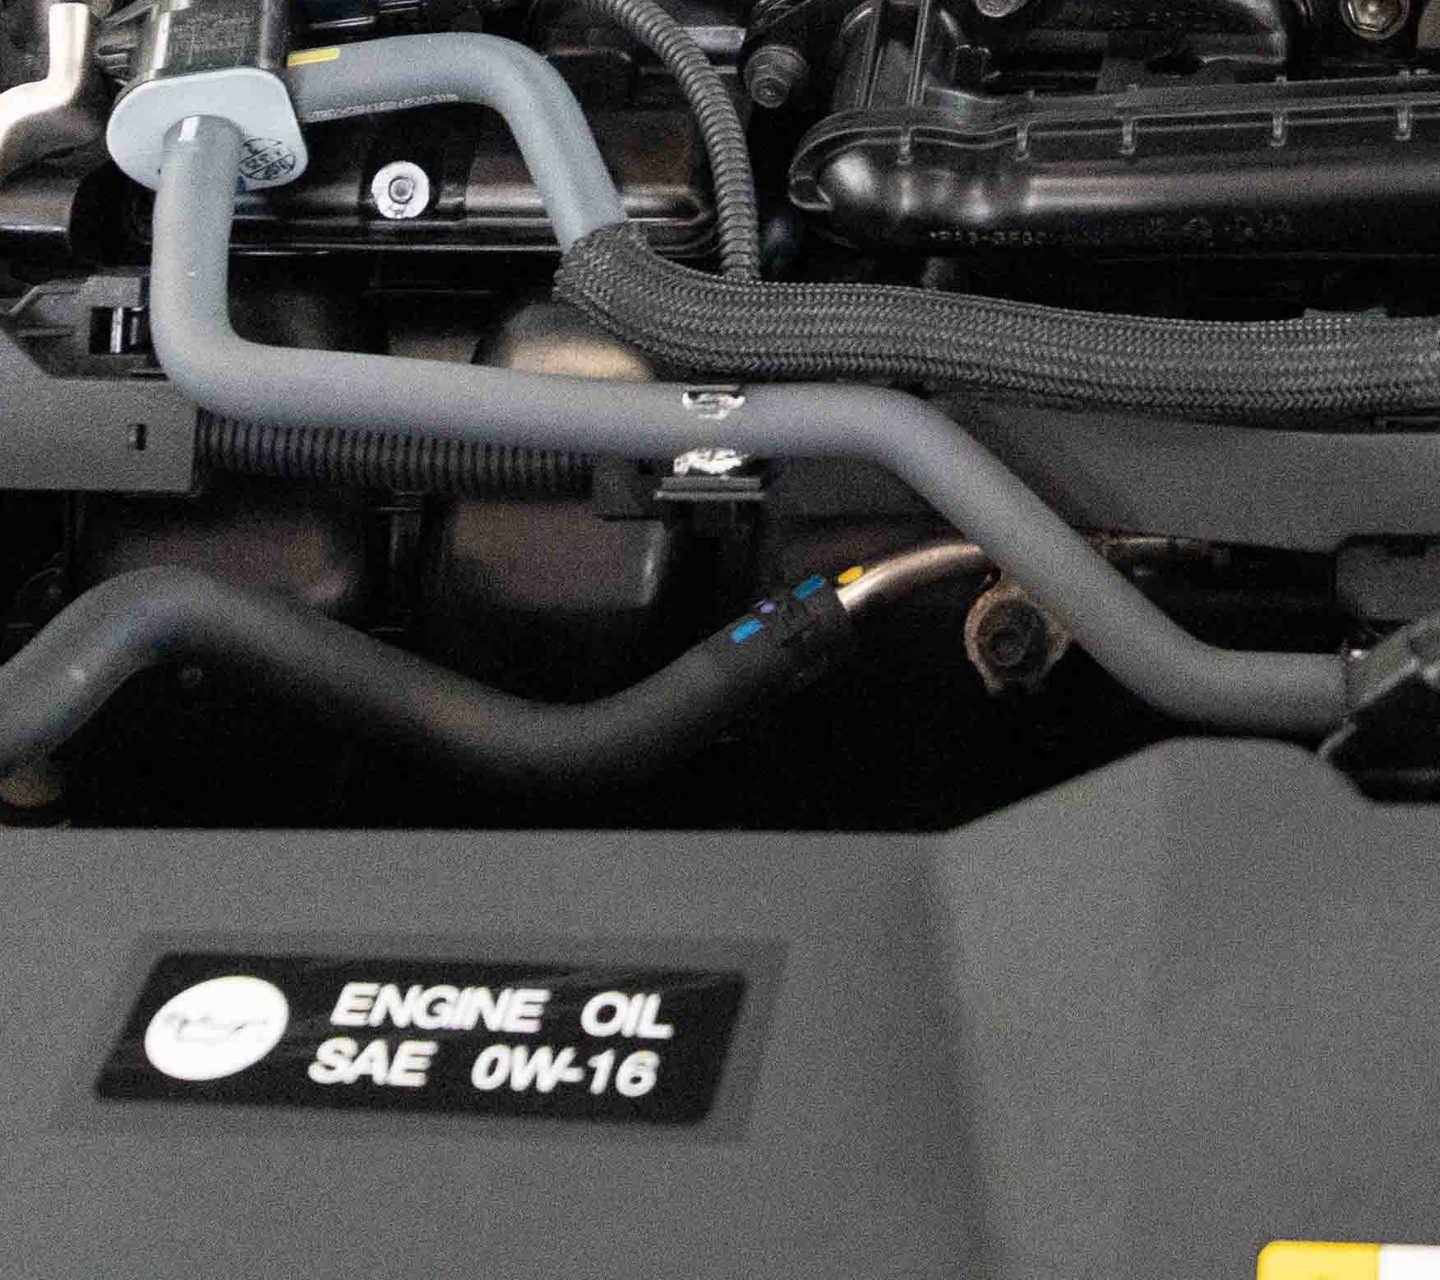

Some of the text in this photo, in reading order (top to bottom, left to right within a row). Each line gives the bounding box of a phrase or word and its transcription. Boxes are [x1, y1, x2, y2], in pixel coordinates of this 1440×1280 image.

[330, 981, 674, 1040] ENGINE OIL
[307, 1037, 660, 1098] SAE 0W-16
